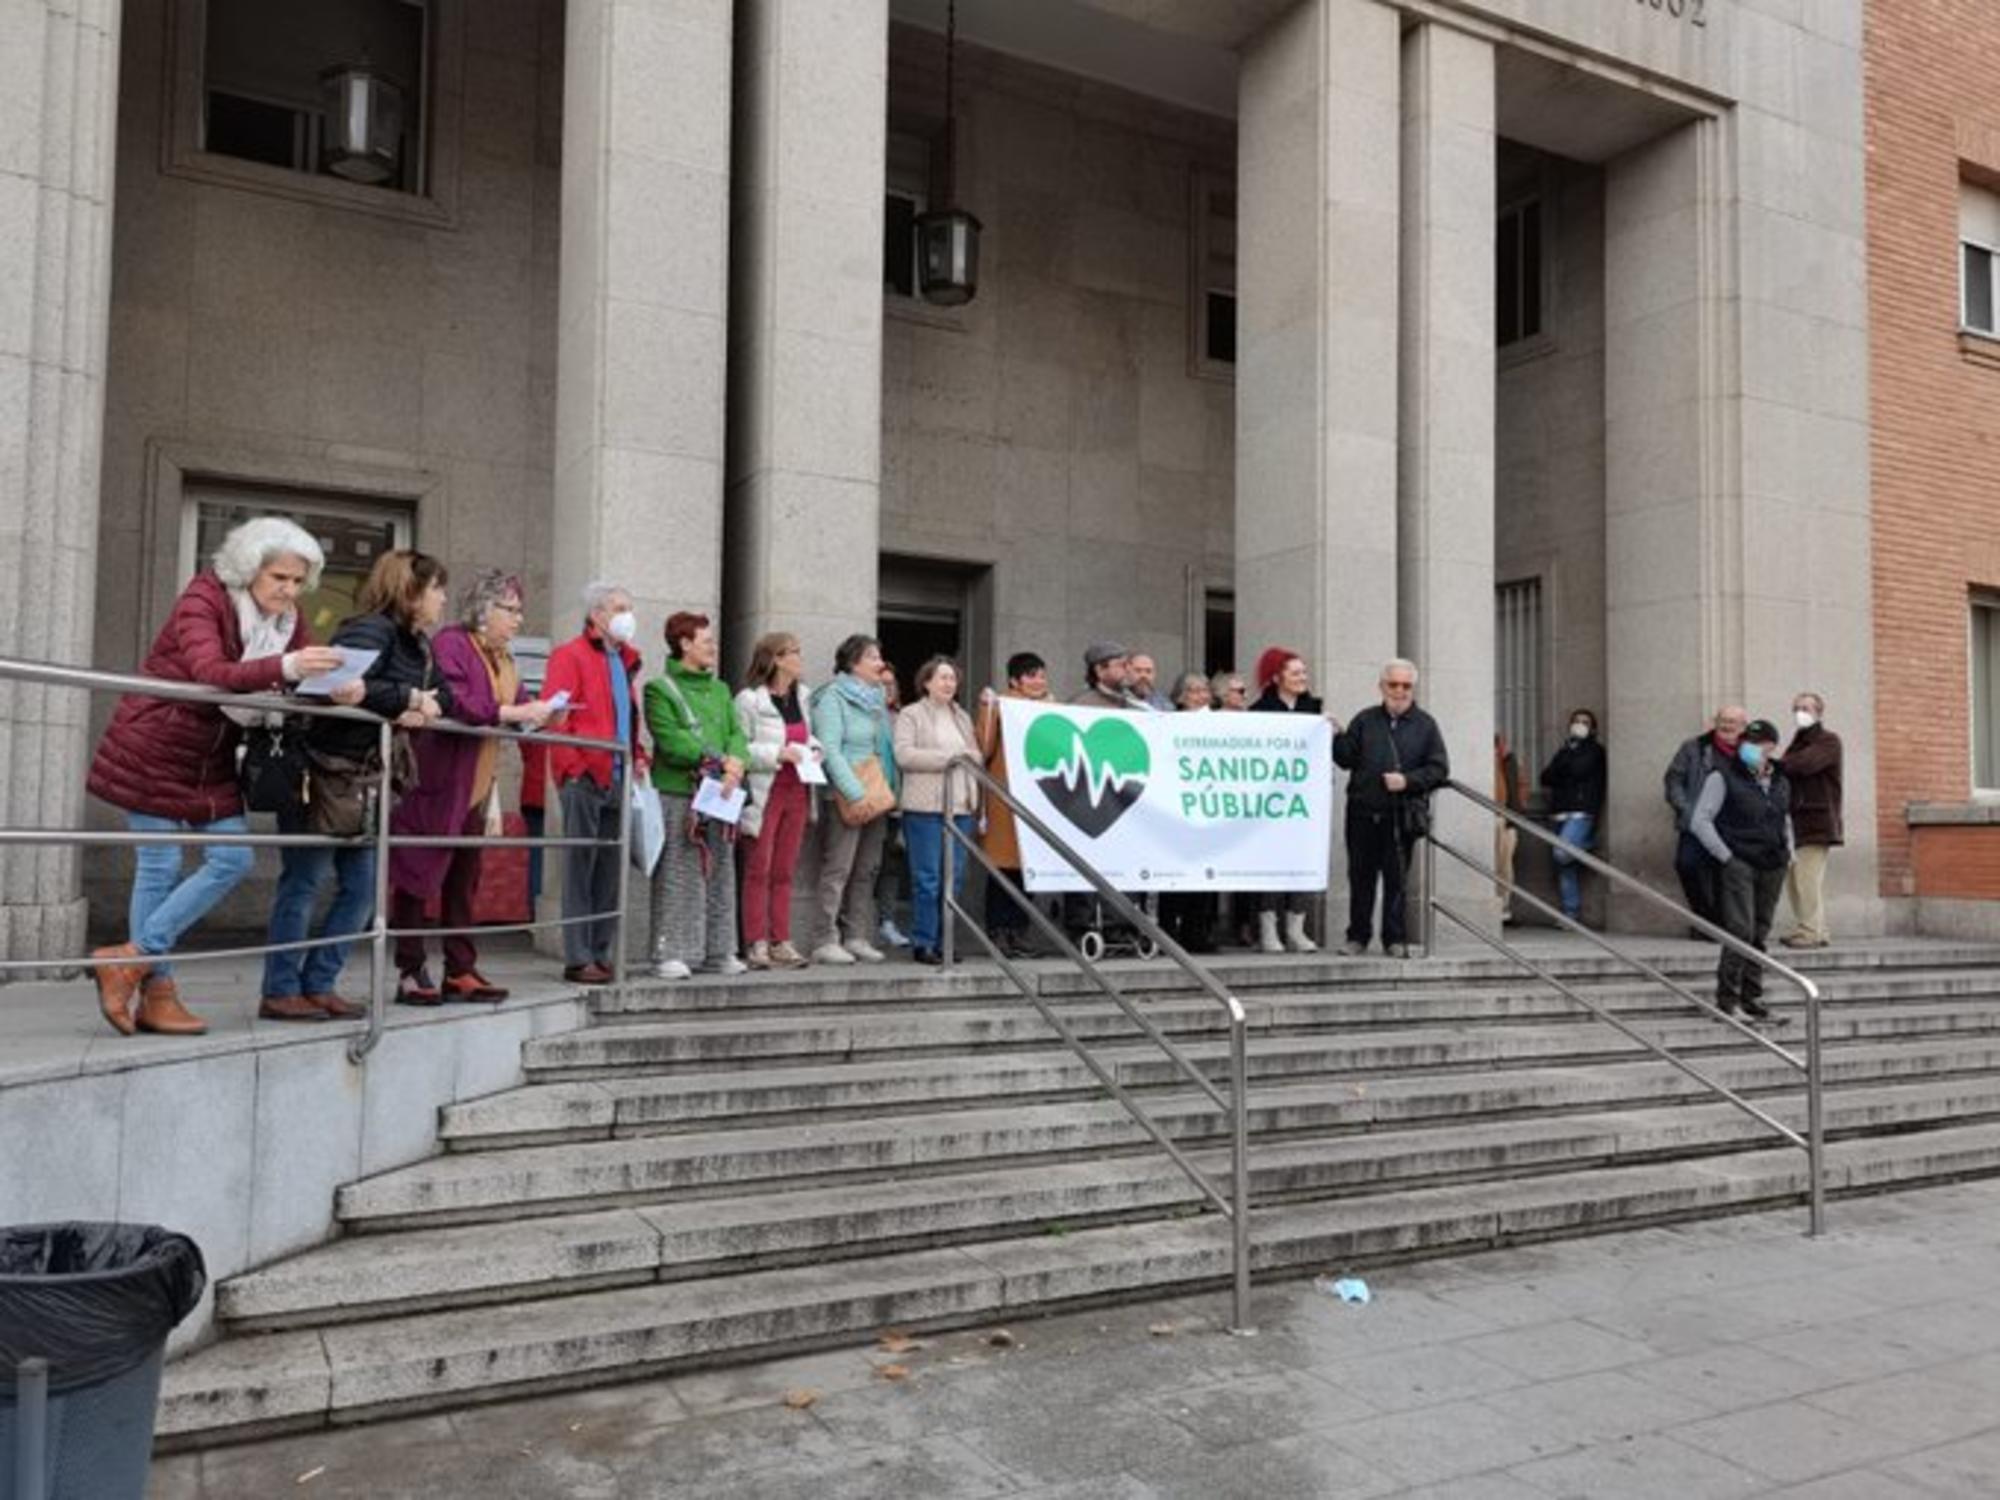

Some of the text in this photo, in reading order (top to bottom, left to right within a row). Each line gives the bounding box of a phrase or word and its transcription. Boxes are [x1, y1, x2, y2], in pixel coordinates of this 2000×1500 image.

[1173, 736, 1308, 750] EXTREMADURA POR LA
[1178, 755, 1309, 782] SANIDAD
[1181, 784, 1309, 818] PÚBLICA
